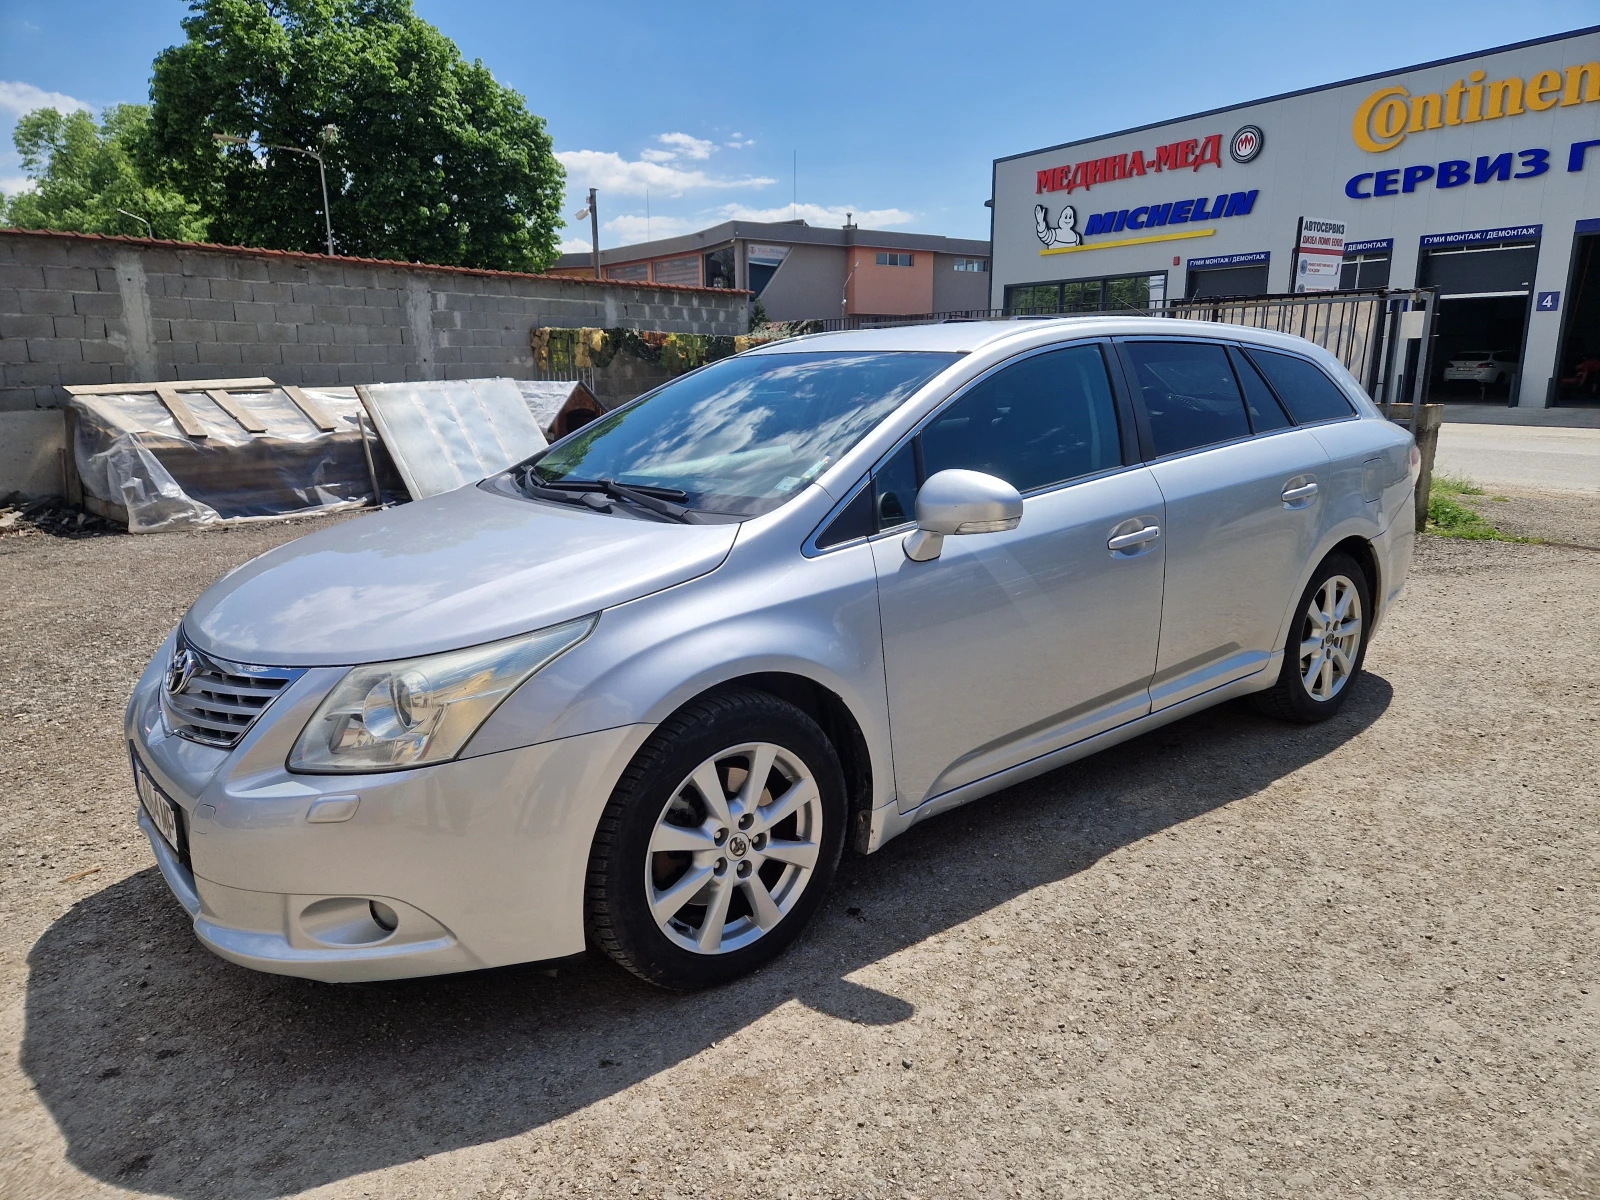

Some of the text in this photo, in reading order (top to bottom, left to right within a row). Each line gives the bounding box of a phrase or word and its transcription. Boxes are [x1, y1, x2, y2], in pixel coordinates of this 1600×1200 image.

[1036, 134, 1222, 194] МЕДИНА-МЕД
[1345, 148, 1550, 199] СЕРВИЗ
[1083, 190, 1259, 236] MICHELIN
[1303, 220, 1345, 235] АВТОСЕРВИЗ
[1424, 237, 1445, 245] ГУМИ
[1446, 233, 1482, 243] МОНТАЖ
[1487, 227, 1536, 239] ДЕМОНТАЖ
[1347, 241, 1388, 252] ДЕМОНТАЖ
[1190, 259, 1205, 267] ГУМИ
[1205, 257, 1229, 265] МОНТАЖ
[1232, 253, 1266, 263] ДЕМОНТАЖ
[1541, 294, 1553, 308] 4
